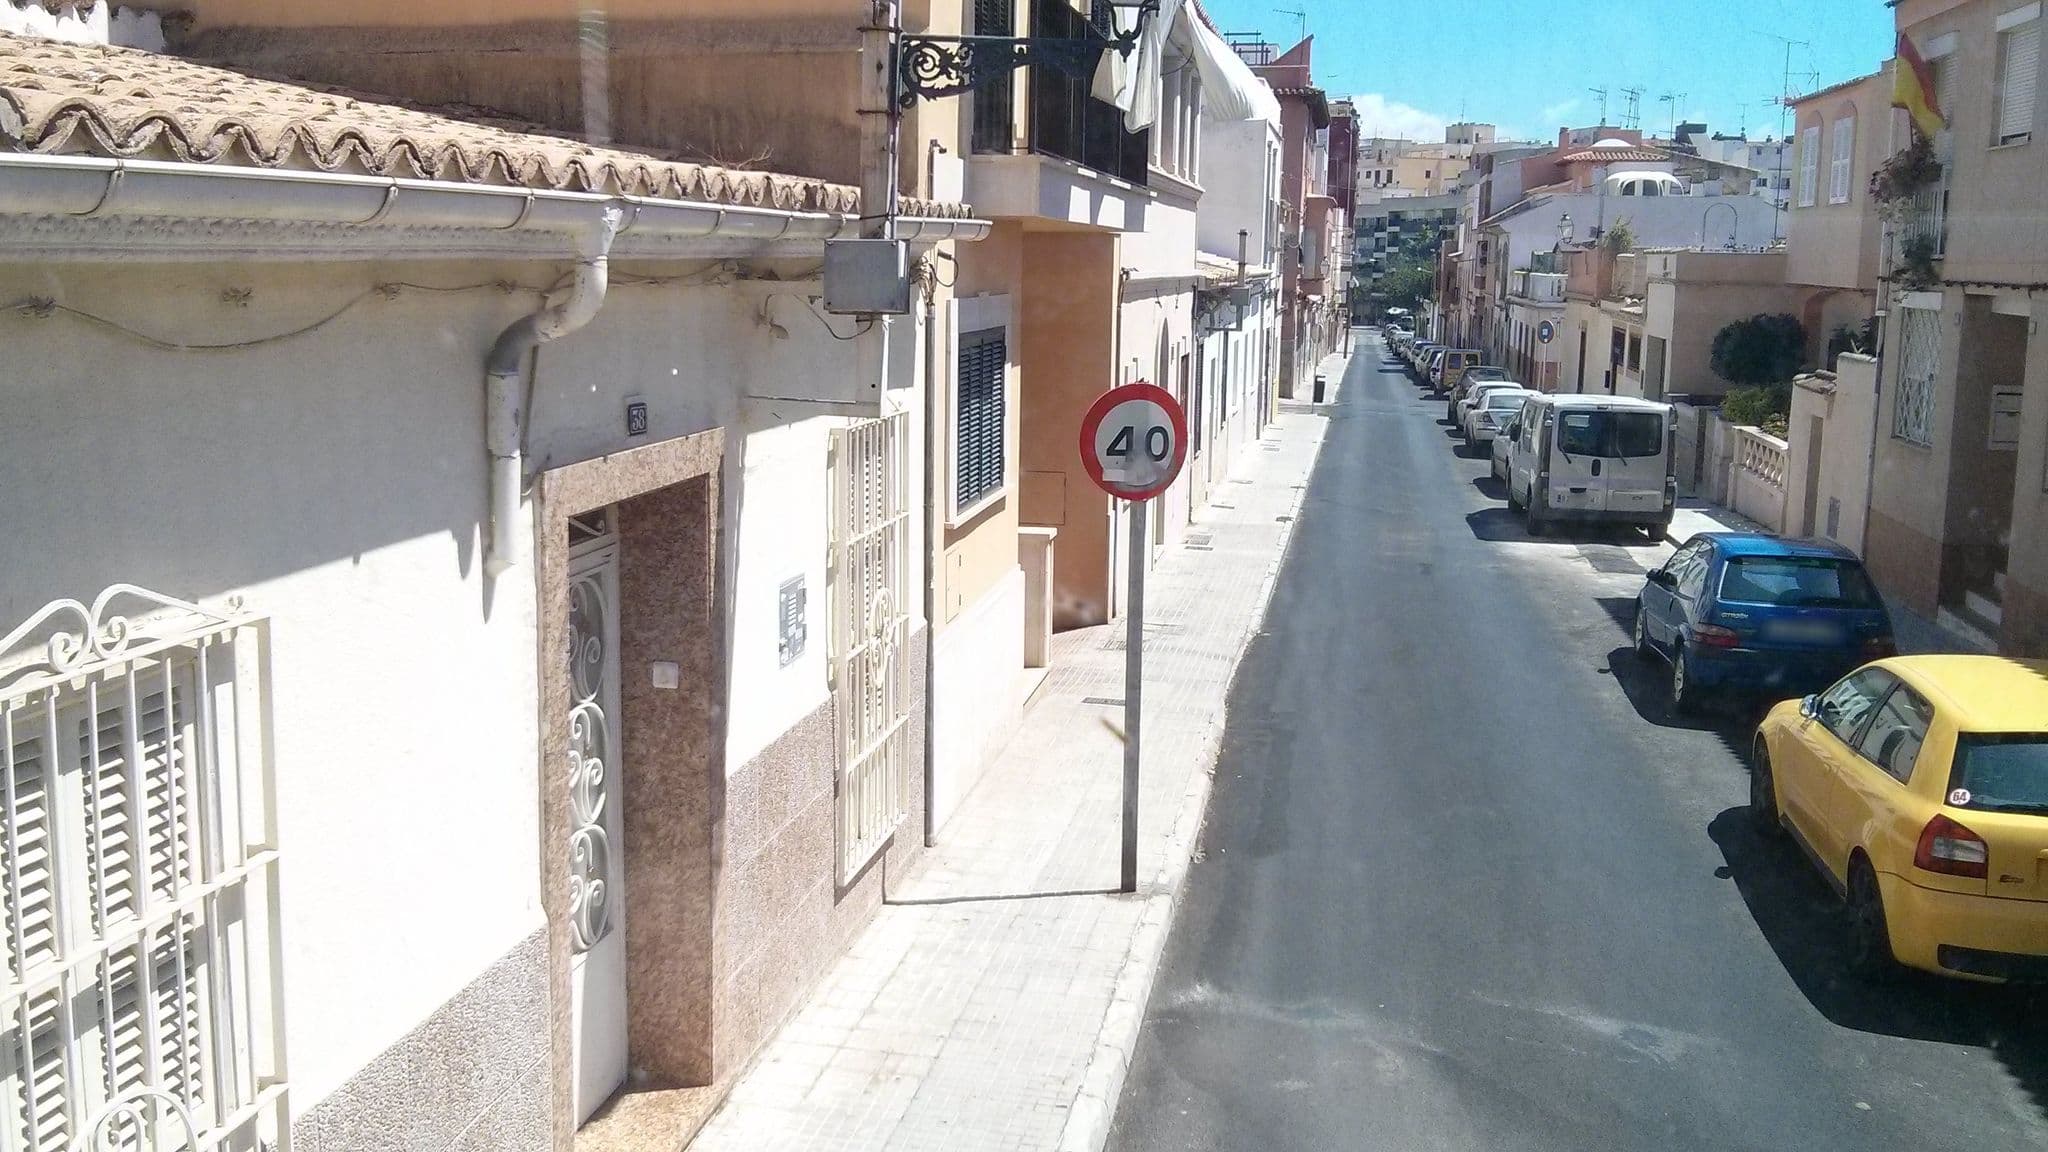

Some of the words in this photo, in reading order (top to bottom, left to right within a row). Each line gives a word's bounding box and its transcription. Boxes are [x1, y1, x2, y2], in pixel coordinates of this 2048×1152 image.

[632, 409, 645, 431] 38
[1106, 425, 1170, 463] 40
[1952, 791, 1967, 802] 64
